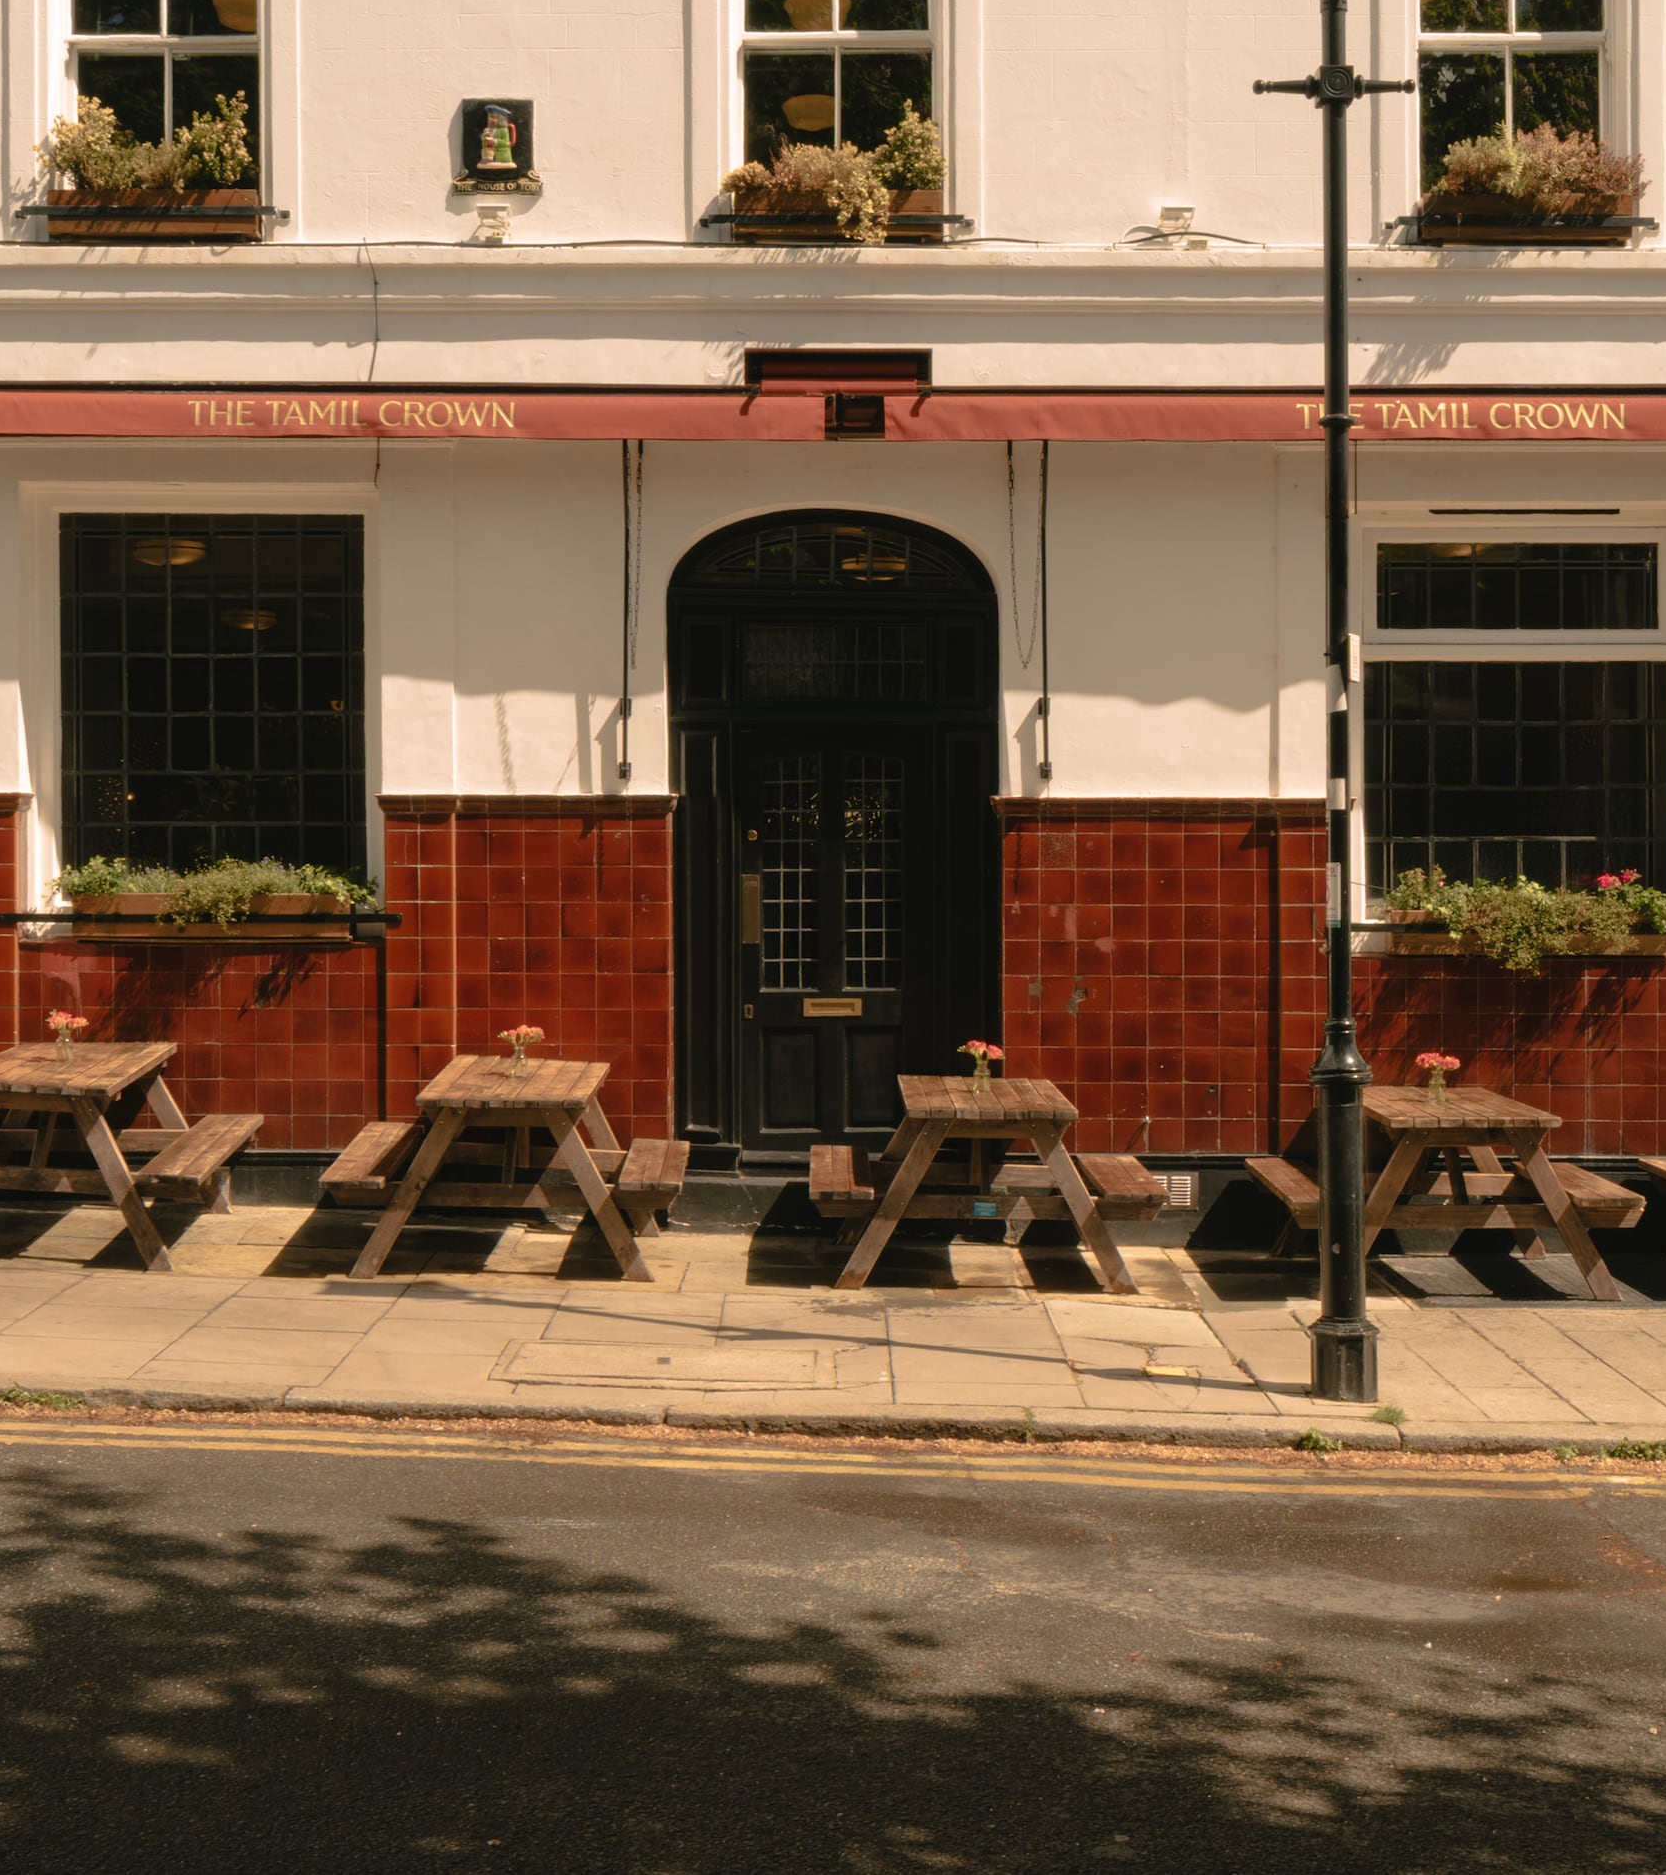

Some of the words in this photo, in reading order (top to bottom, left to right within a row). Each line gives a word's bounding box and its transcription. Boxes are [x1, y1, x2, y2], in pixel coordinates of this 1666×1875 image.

[478, 182, 505, 192] HOUSE
[188, 400, 255, 426] THE
[266, 400, 368, 426] TAMIL
[379, 400, 515, 427] CROWN
[1296, 403, 1365, 429] TE
[1374, 403, 1478, 429] TAMIL
[1489, 403, 1626, 430] CROWN
